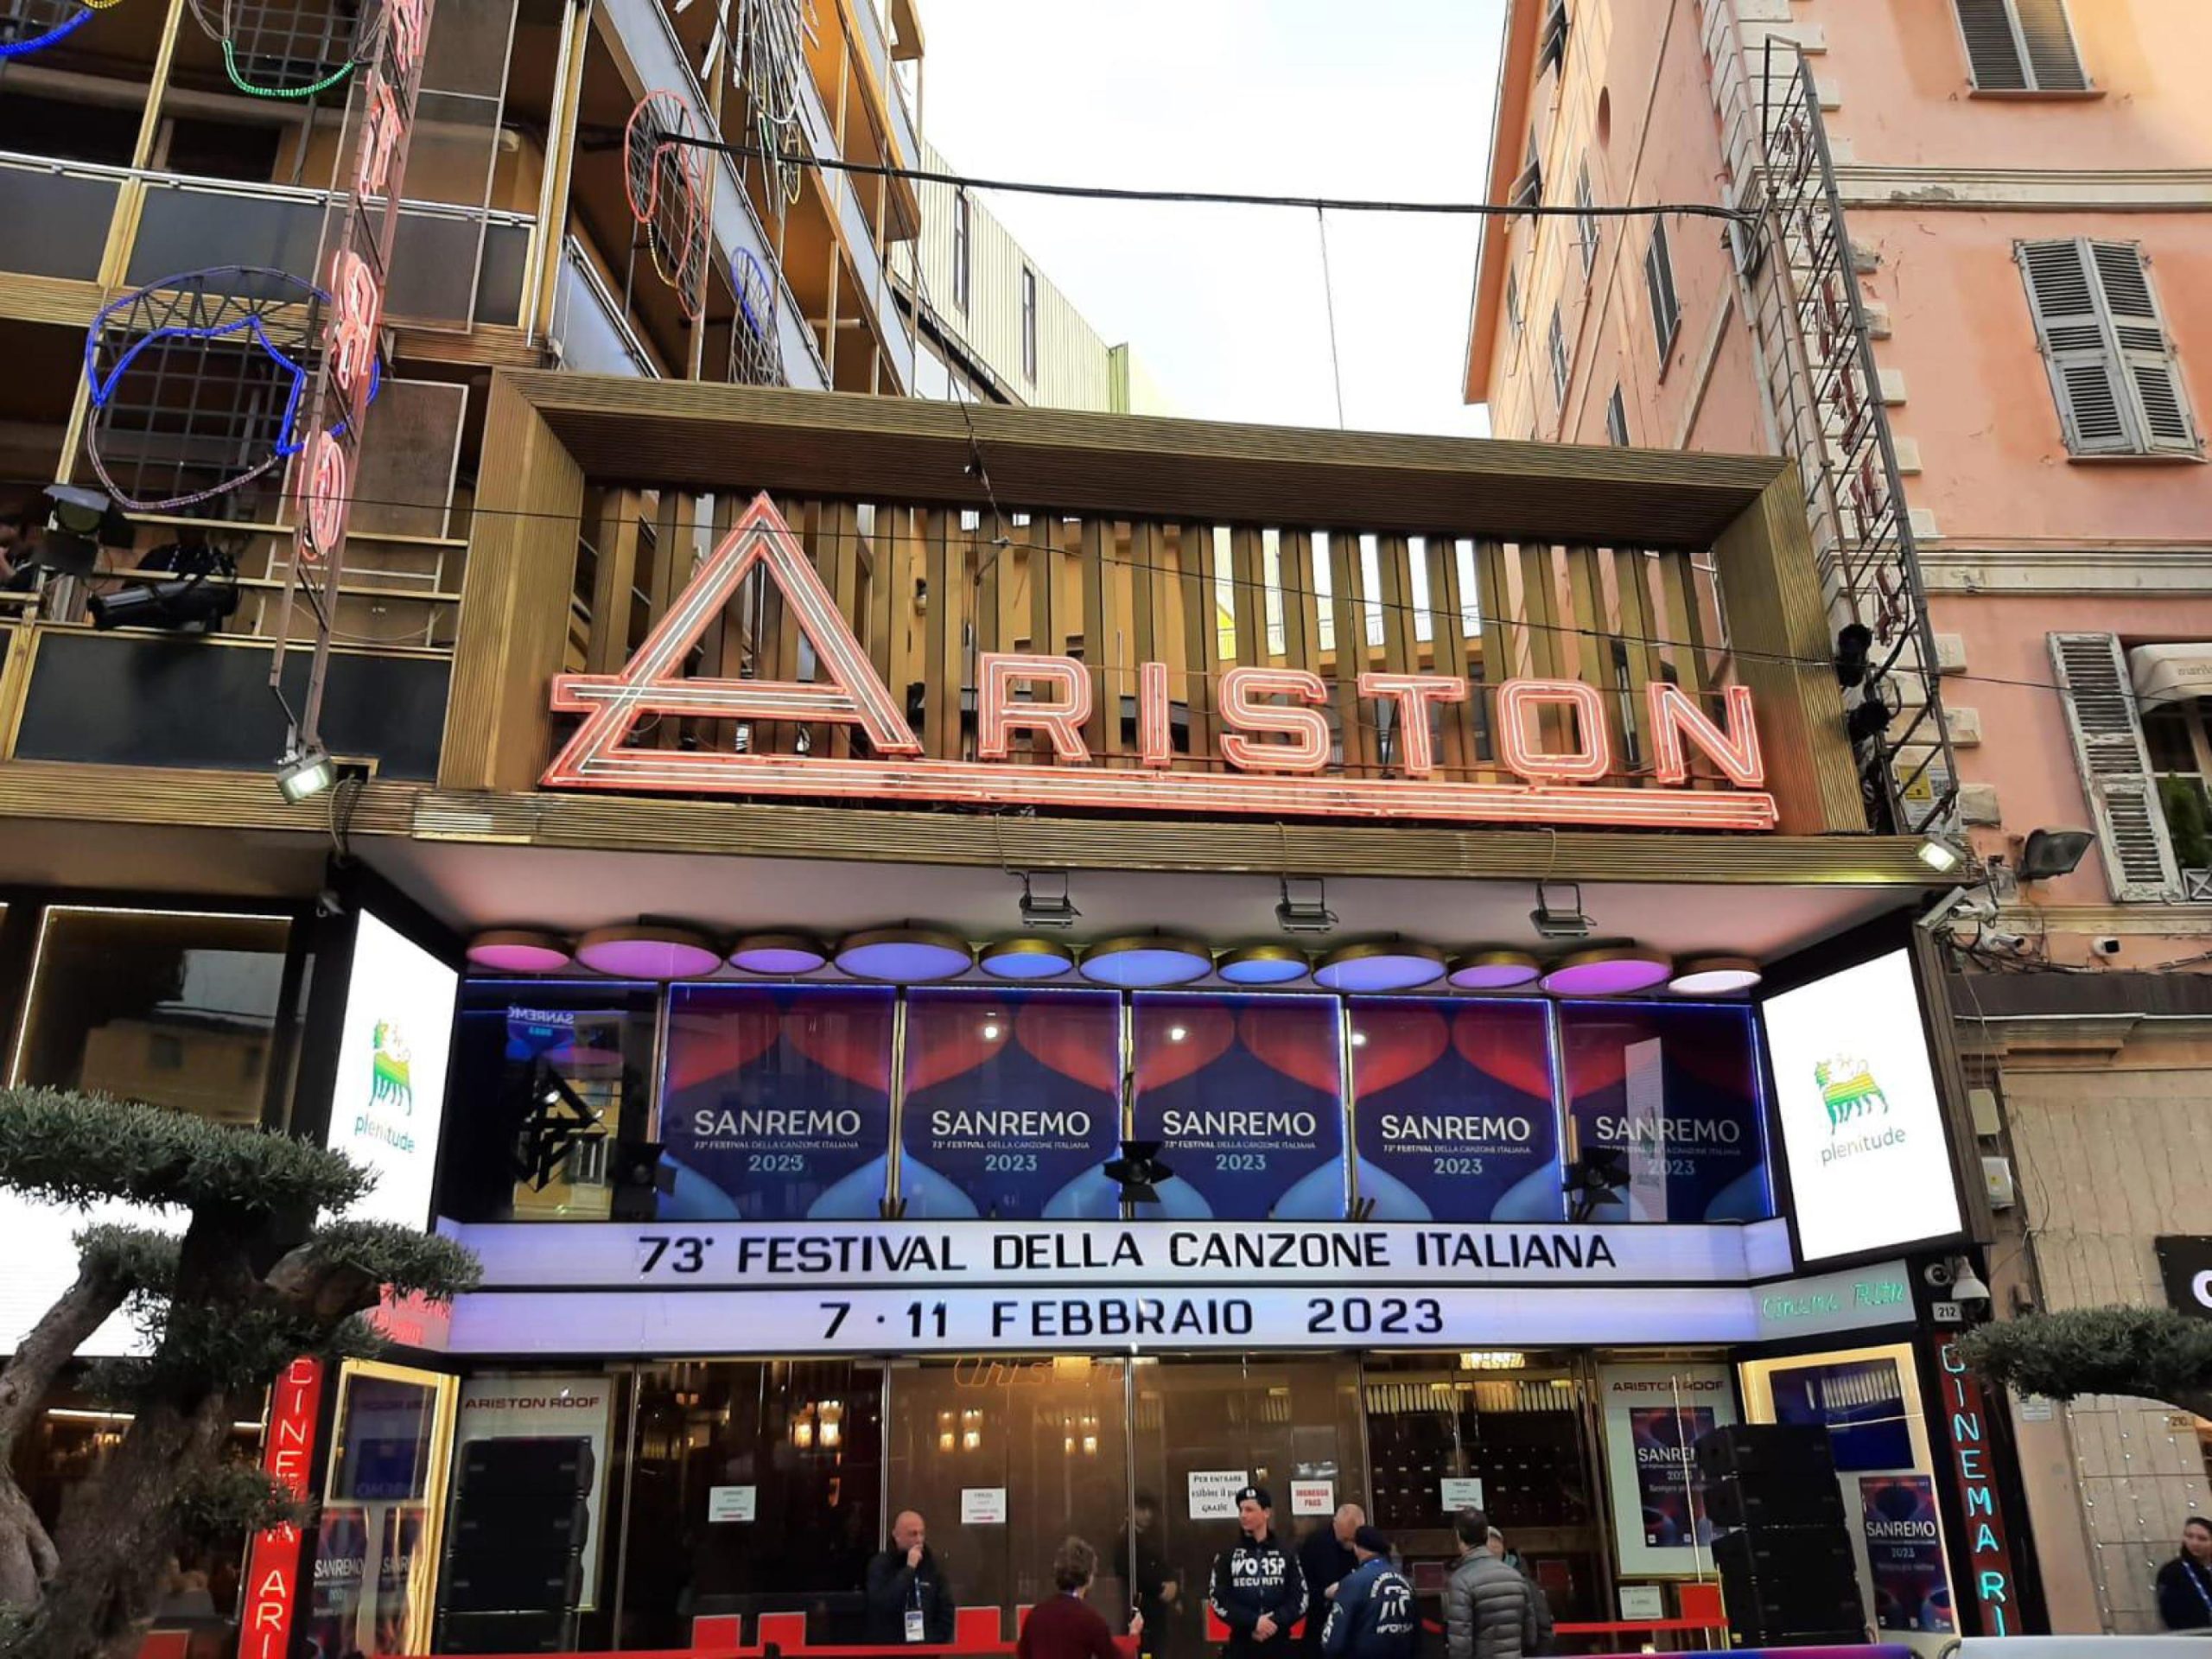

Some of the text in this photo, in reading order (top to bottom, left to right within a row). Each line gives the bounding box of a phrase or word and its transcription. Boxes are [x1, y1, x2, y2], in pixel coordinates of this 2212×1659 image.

[542, 489, 1773, 793] ARISTON
[354, 1113, 416, 1154] plenitude
[694, 1109, 861, 1136] SANREMO
[931, 1109, 1091, 1136] SANREMO
[1162, 1109, 1317, 1136] SANREMO
[1381, 1115, 1530, 1141] SANREMO
[1596, 1116, 1741, 1143] SANREMO
[947, 1140, 986, 1149] FESTIVAL
[1179, 1140, 1216, 1149] FESTIVAL
[1821, 1125, 1906, 1167] plenitude
[748, 1154, 804, 1172] 2023
[985, 1154, 1038, 1172] 2023
[1216, 1154, 1267, 1171] 2023
[1434, 1158, 1484, 1175] 2023
[1648, 1159, 1696, 1176] 2023
[738, 1235, 967, 1273] FESTIVAL
[993, 1232, 1143, 1269] DELLA
[1170, 1231, 1390, 1268] CANZONE
[1417, 1232, 1617, 1268] ITALIANA
[906, 1300, 947, 1338] 11
[991, 1298, 1253, 1338] FEBBRAIO
[1307, 1298, 1444, 1334] 2023
[1938, 1306, 1957, 1318] 212
[465, 1395, 601, 1410] ARISTON ROOF
[1941, 1344, 1999, 1554] CINEMA
[1866, 1520, 1936, 1538] SANREMO
[1233, 1576, 1285, 1587] SECURITY
